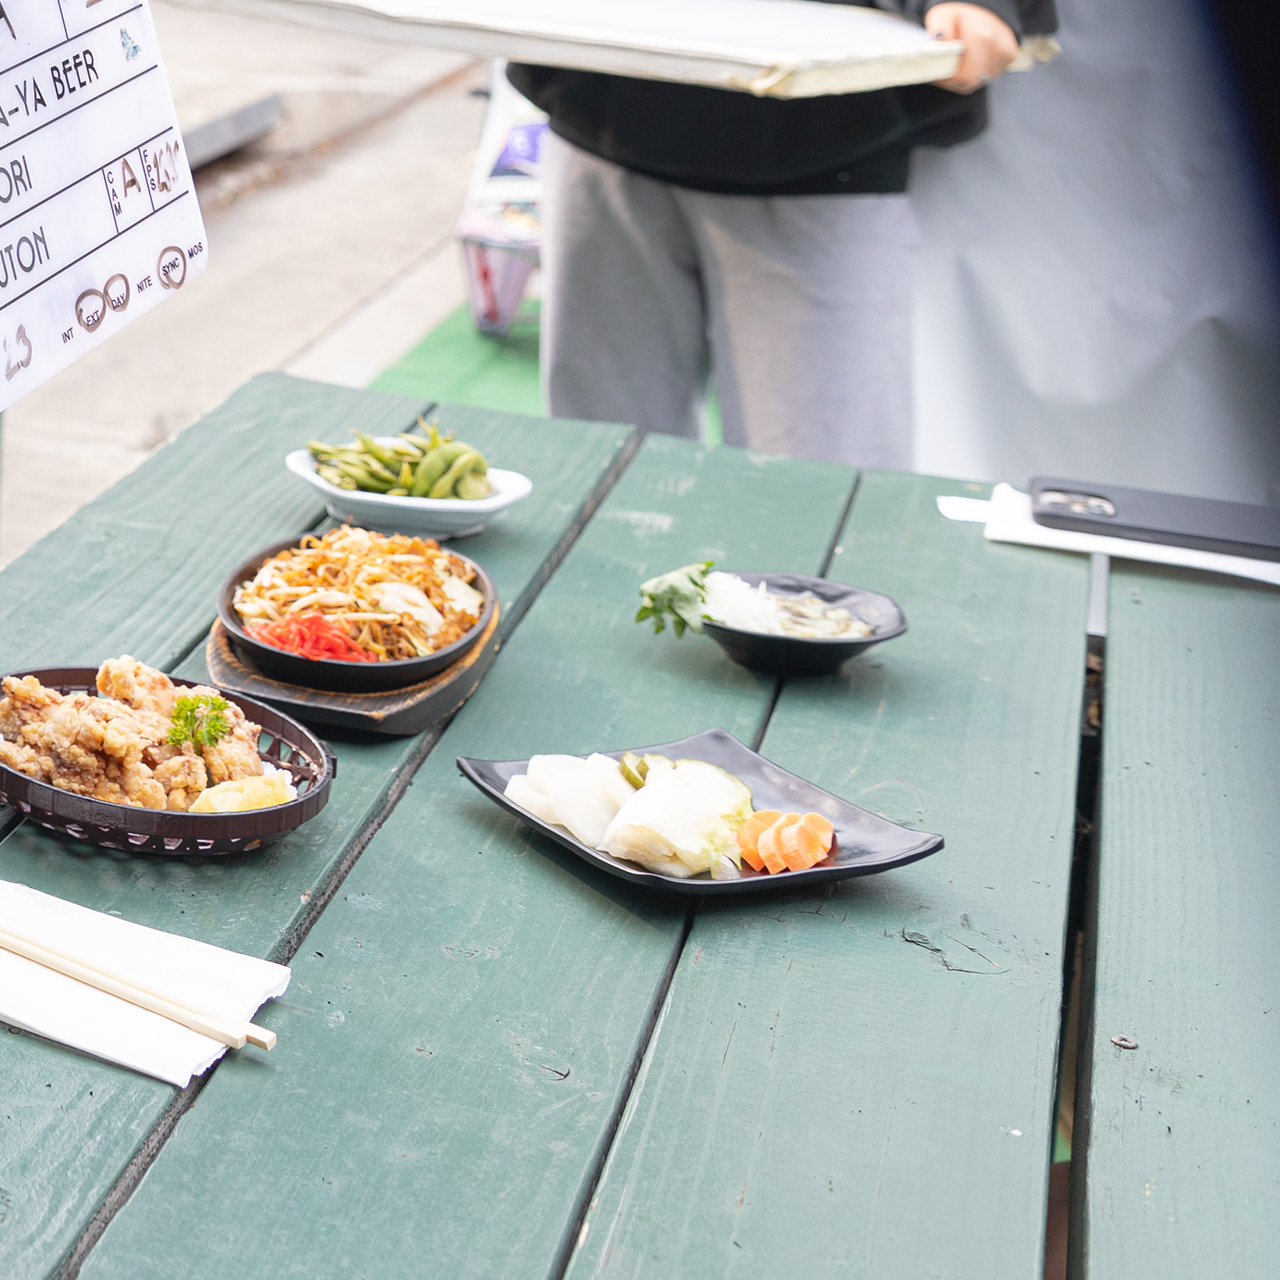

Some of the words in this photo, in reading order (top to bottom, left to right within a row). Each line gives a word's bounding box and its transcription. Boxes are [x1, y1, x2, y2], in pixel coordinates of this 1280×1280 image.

[50, 49, 99, 100] BEER
[121, 158, 141, 198] A
[143, 149, 156, 191] FPS
[107, 171, 122, 216] CAM
[61, 327, 74, 344] INT
[85, 310, 100, 327] EXT
[111, 293, 126, 310] DAY
[136, 276, 153, 293] NITE
[161, 257, 180, 276] SYNC
[187, 242, 203, 260] MOS
